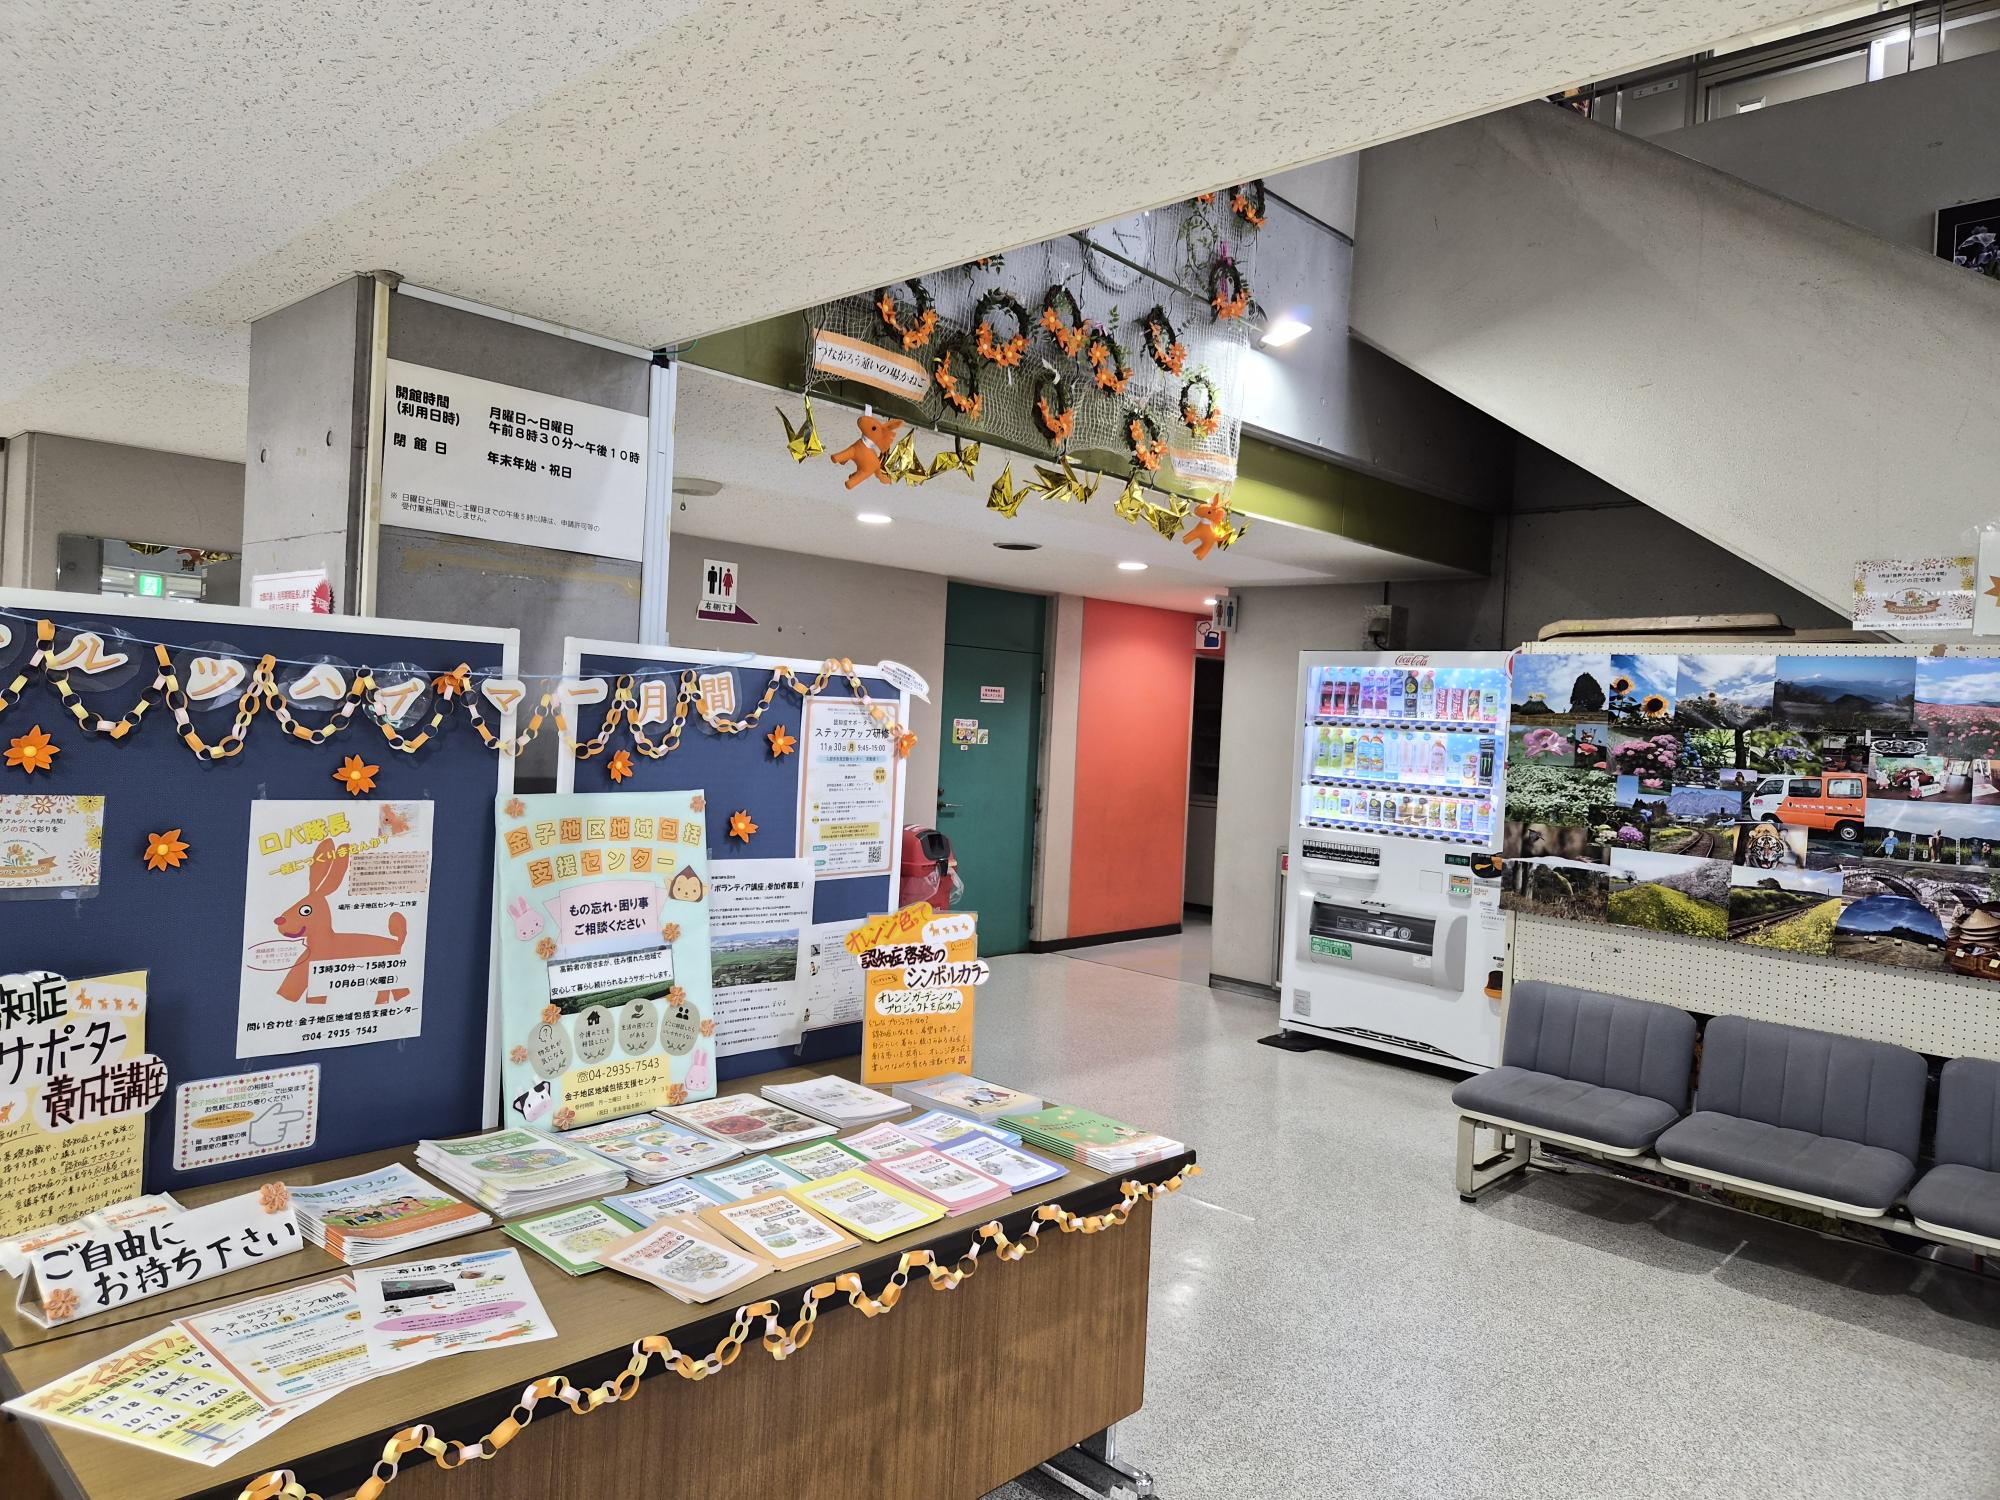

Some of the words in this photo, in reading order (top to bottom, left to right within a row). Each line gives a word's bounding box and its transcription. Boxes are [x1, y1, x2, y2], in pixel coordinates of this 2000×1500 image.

[395, 384, 450, 410] 開館時間
[397, 401, 461, 427] (利用日時)
[487, 451, 573, 479] 年末年始・祝日
[815, 728, 890, 740] ステップアップ研修
[258, 812, 351, 855] ロバ隊長
[507, 818, 702, 856] 金子地区地域包括
[529, 850, 674, 886] 支援センター
[569, 896, 649, 917] もの忘れ・困り事
[574, 917, 646, 937] ご相談ください
[846, 904, 928, 952] オレンジ色って
[860, 944, 947, 969] 認知症啓発の
[329, 975, 399, 989] 10月6日(火曜日)
[907, 964, 989, 988] シンボルカラー
[0, 973, 67, 1031] 知症
[0, 1022, 127, 1085] サポーター
[42, 1056, 168, 1129] 養成講座
[564, 1075, 665, 1101] 金子地区地域包括支援センター
[43, 1222, 186, 1280] ご自由に
[93, 1222, 297, 1305] お持ち下さい
[122, 1406, 164, 1428] 10/17
[172, 1381, 212, 1402] 11/21
[196, 1387, 229, 1407] 2/20
